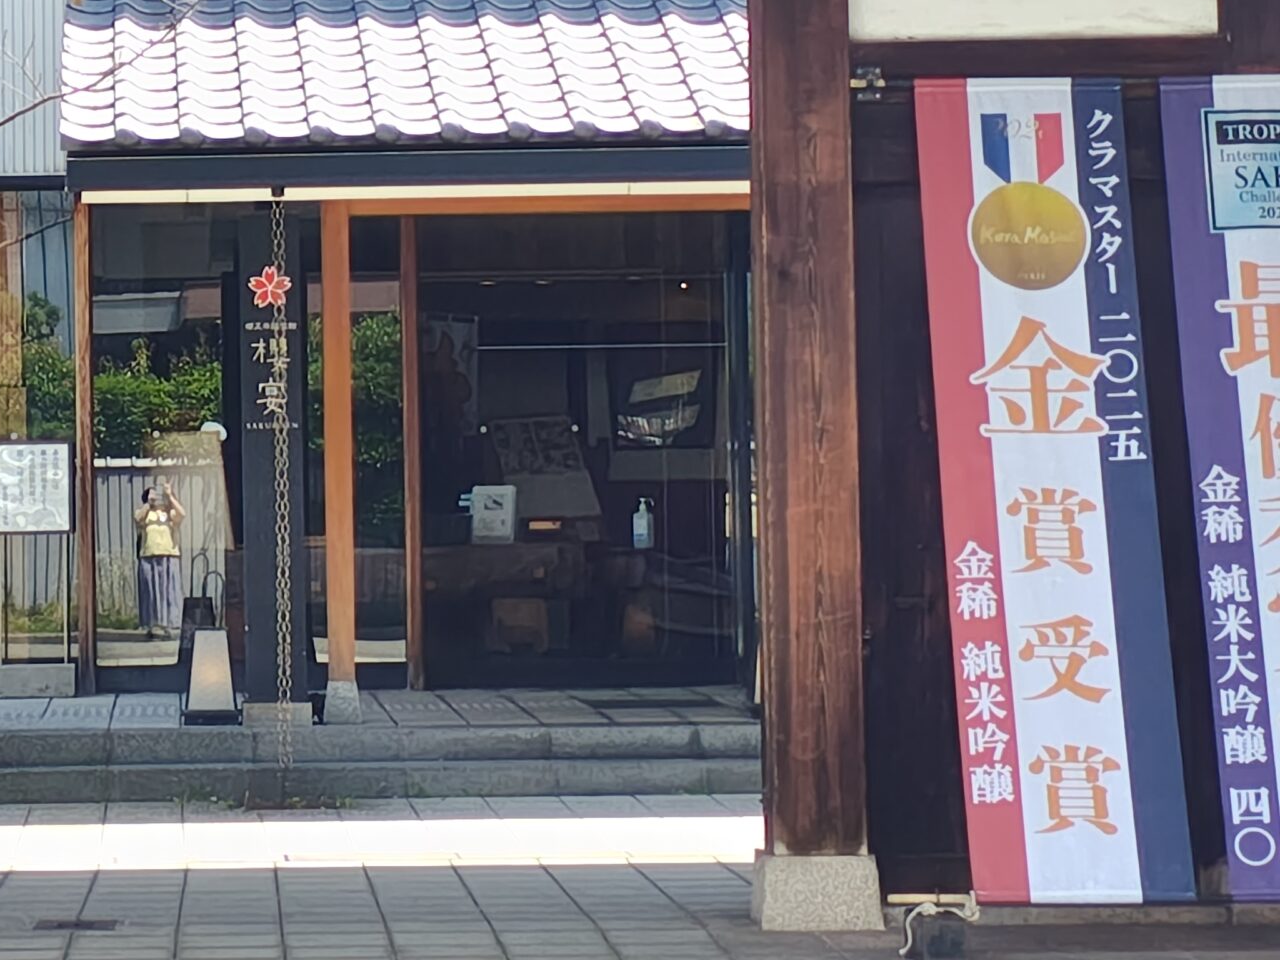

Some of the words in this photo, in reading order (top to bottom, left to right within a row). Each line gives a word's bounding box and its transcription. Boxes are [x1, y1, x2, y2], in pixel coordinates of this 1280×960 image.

[1086, 109, 1123, 294] クラマスター
[953, 540, 998, 620] 金稀
[970, 314, 1121, 836] 金賞受賞
[1198, 464, 1245, 544] 金稀
[960, 641, 1015, 804] 純米吟醸
[1207, 563, 1268, 765] 純米大吟醸
[1229, 785, 1277, 867] 四〇
